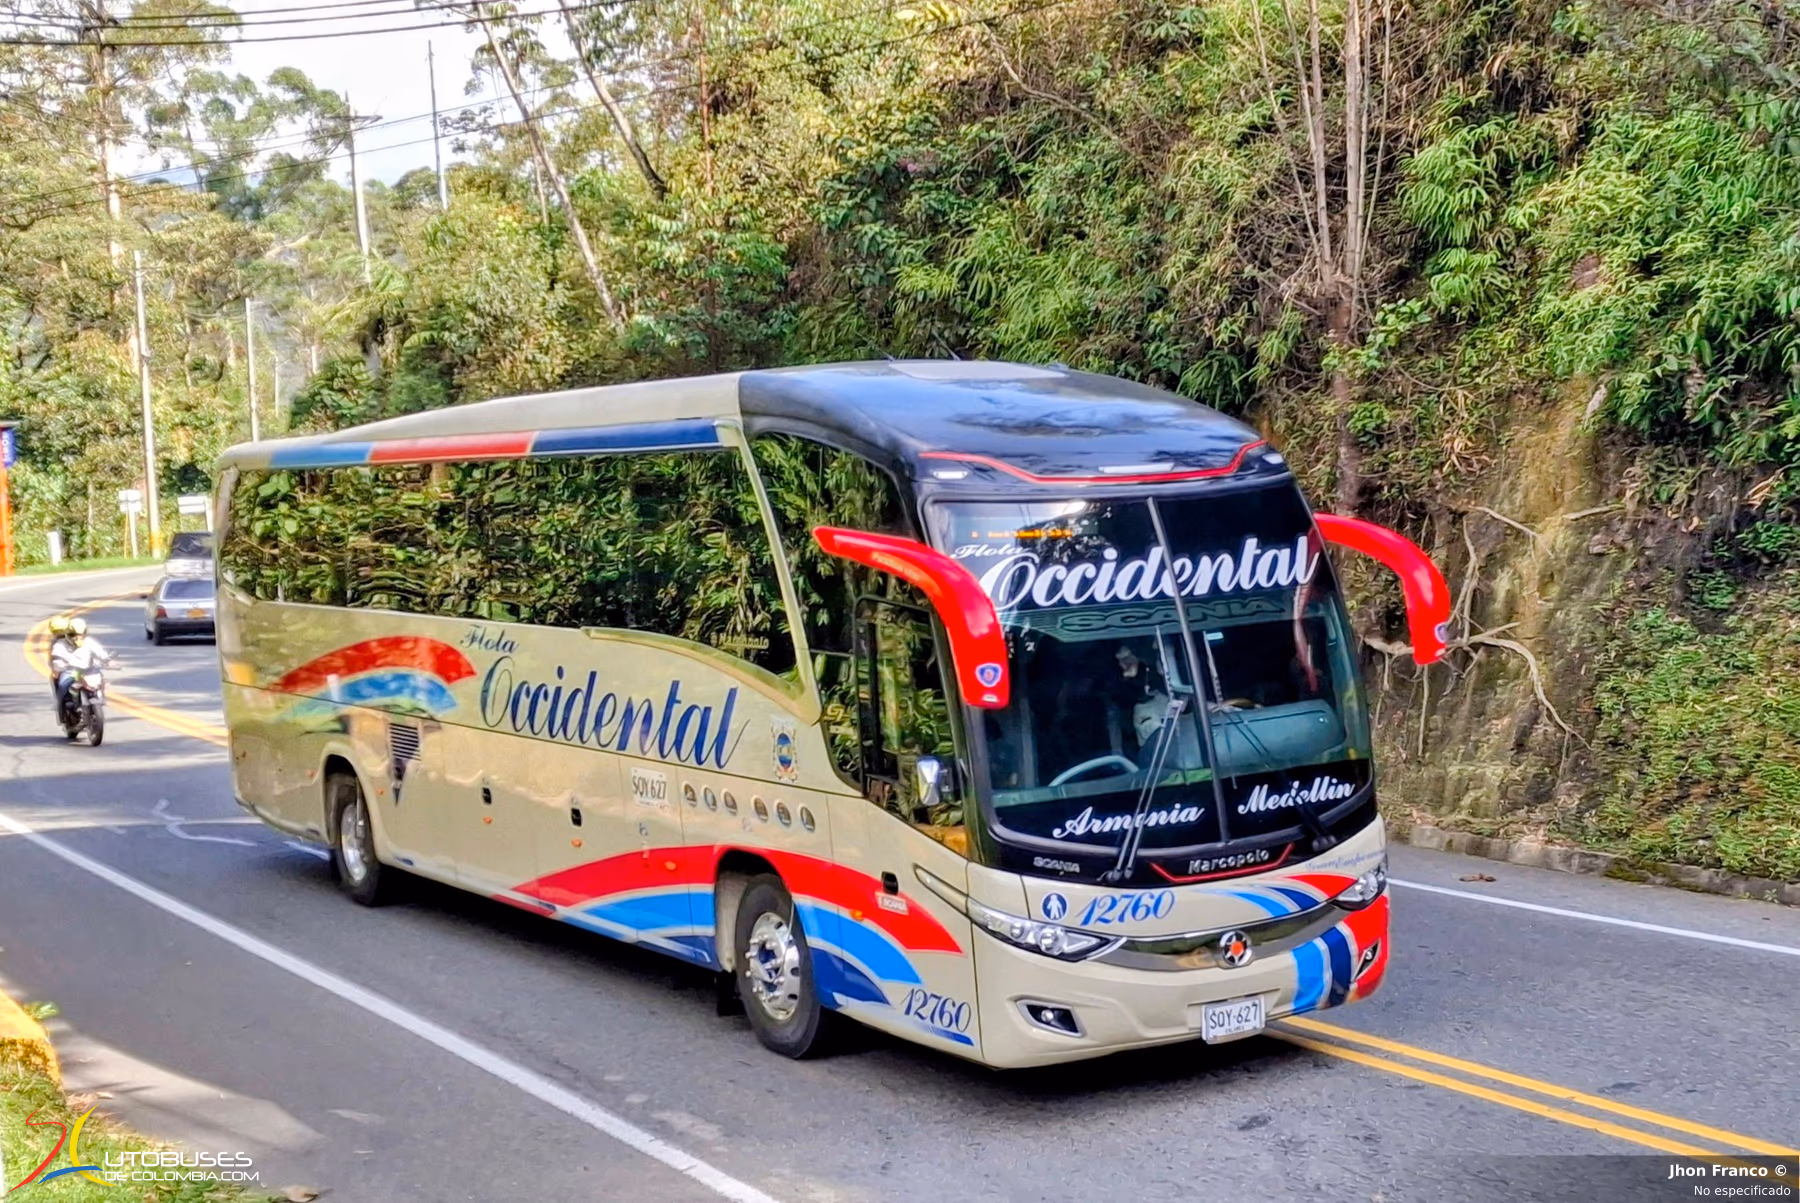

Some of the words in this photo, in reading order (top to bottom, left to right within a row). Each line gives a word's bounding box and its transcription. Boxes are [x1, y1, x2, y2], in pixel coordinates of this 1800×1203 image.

[950, 543, 1032, 559] Flota
[978, 536, 1320, 610] Occidental
[1058, 597, 1285, 633] SCANIA
[460, 624, 520, 653] Flota
[480, 656, 750, 769] Occidental
[1238, 775, 1355, 814] Medellin
[1188, 849, 1270, 874] Marcopolo
[1075, 890, 1175, 926] 12760
[902, 988, 971, 1033] 12760
